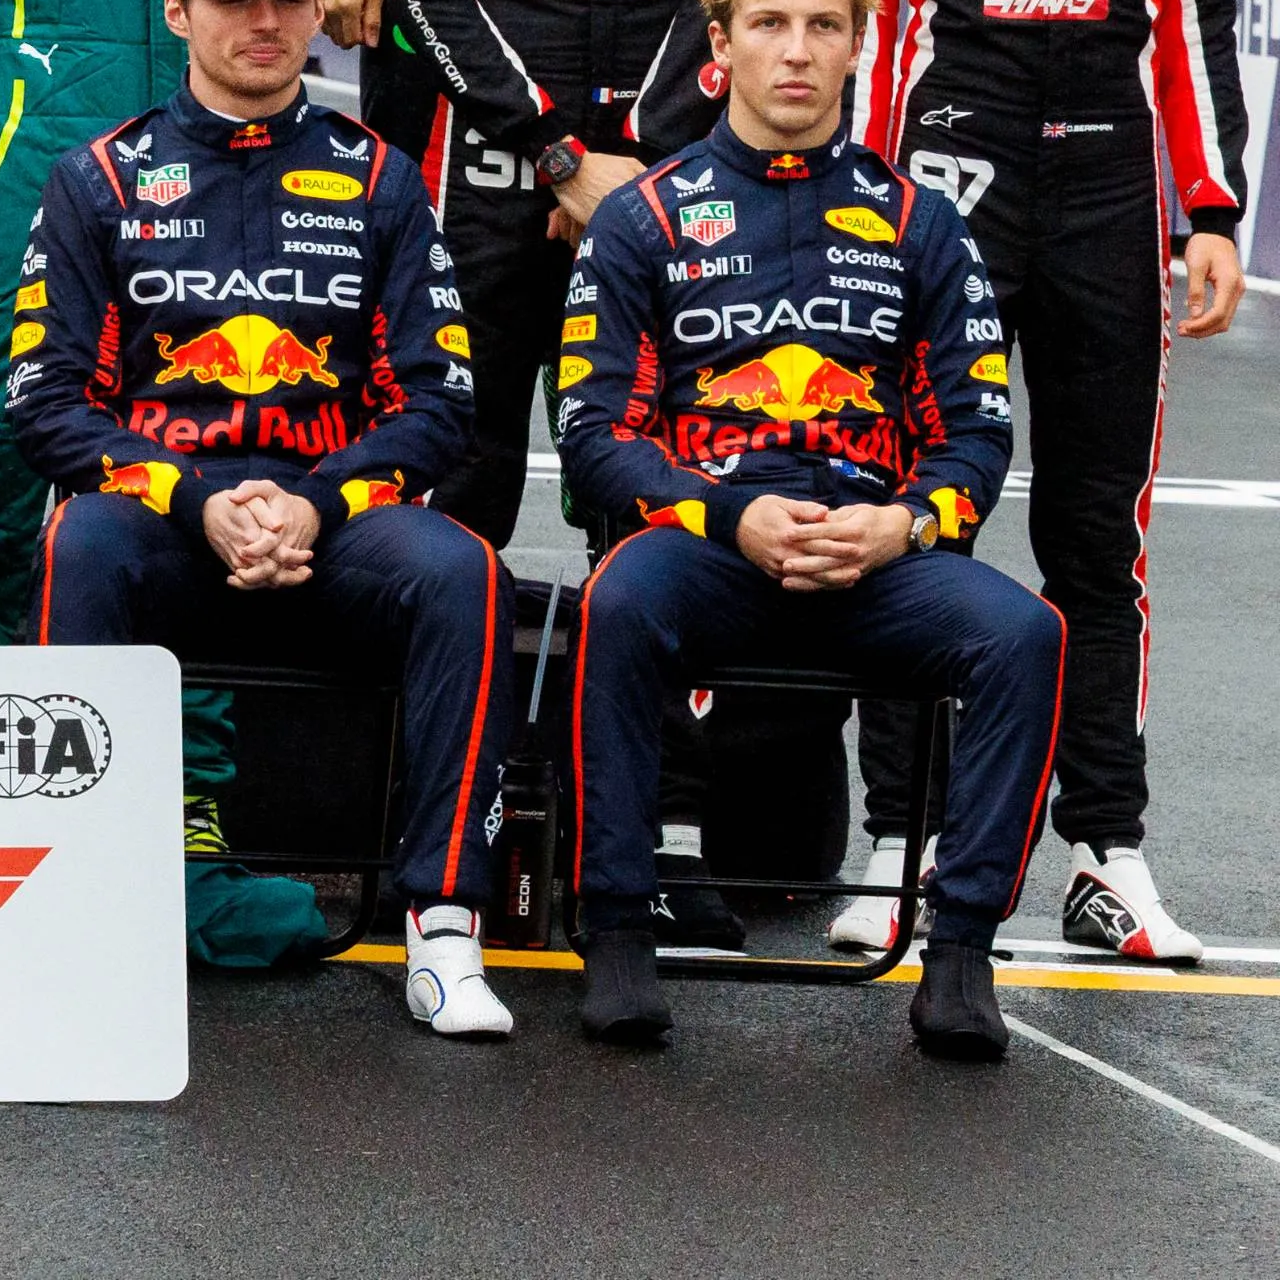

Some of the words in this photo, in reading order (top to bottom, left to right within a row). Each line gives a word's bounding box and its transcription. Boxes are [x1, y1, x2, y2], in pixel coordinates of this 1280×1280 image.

[143, 164, 185, 183] TAG
[910, 150, 995, 217] 97
[139, 182, 188, 201] HEUER
[302, 178, 352, 195] RAUCH
[687, 202, 730, 219] TAG
[121, 220, 181, 240] Mobil
[299, 212, 364, 232] Gate.io
[683, 220, 736, 242] HEUER
[282, 240, 363, 260] HONDA
[667, 257, 729, 282] Mobil
[128, 268, 362, 310] ORACLE
[829, 276, 903, 299] HONDA
[673, 297, 903, 343] ORACLE
[129, 398, 244, 453] Red
[258, 400, 348, 457] Bull
[519, 874, 530, 916] OCON
